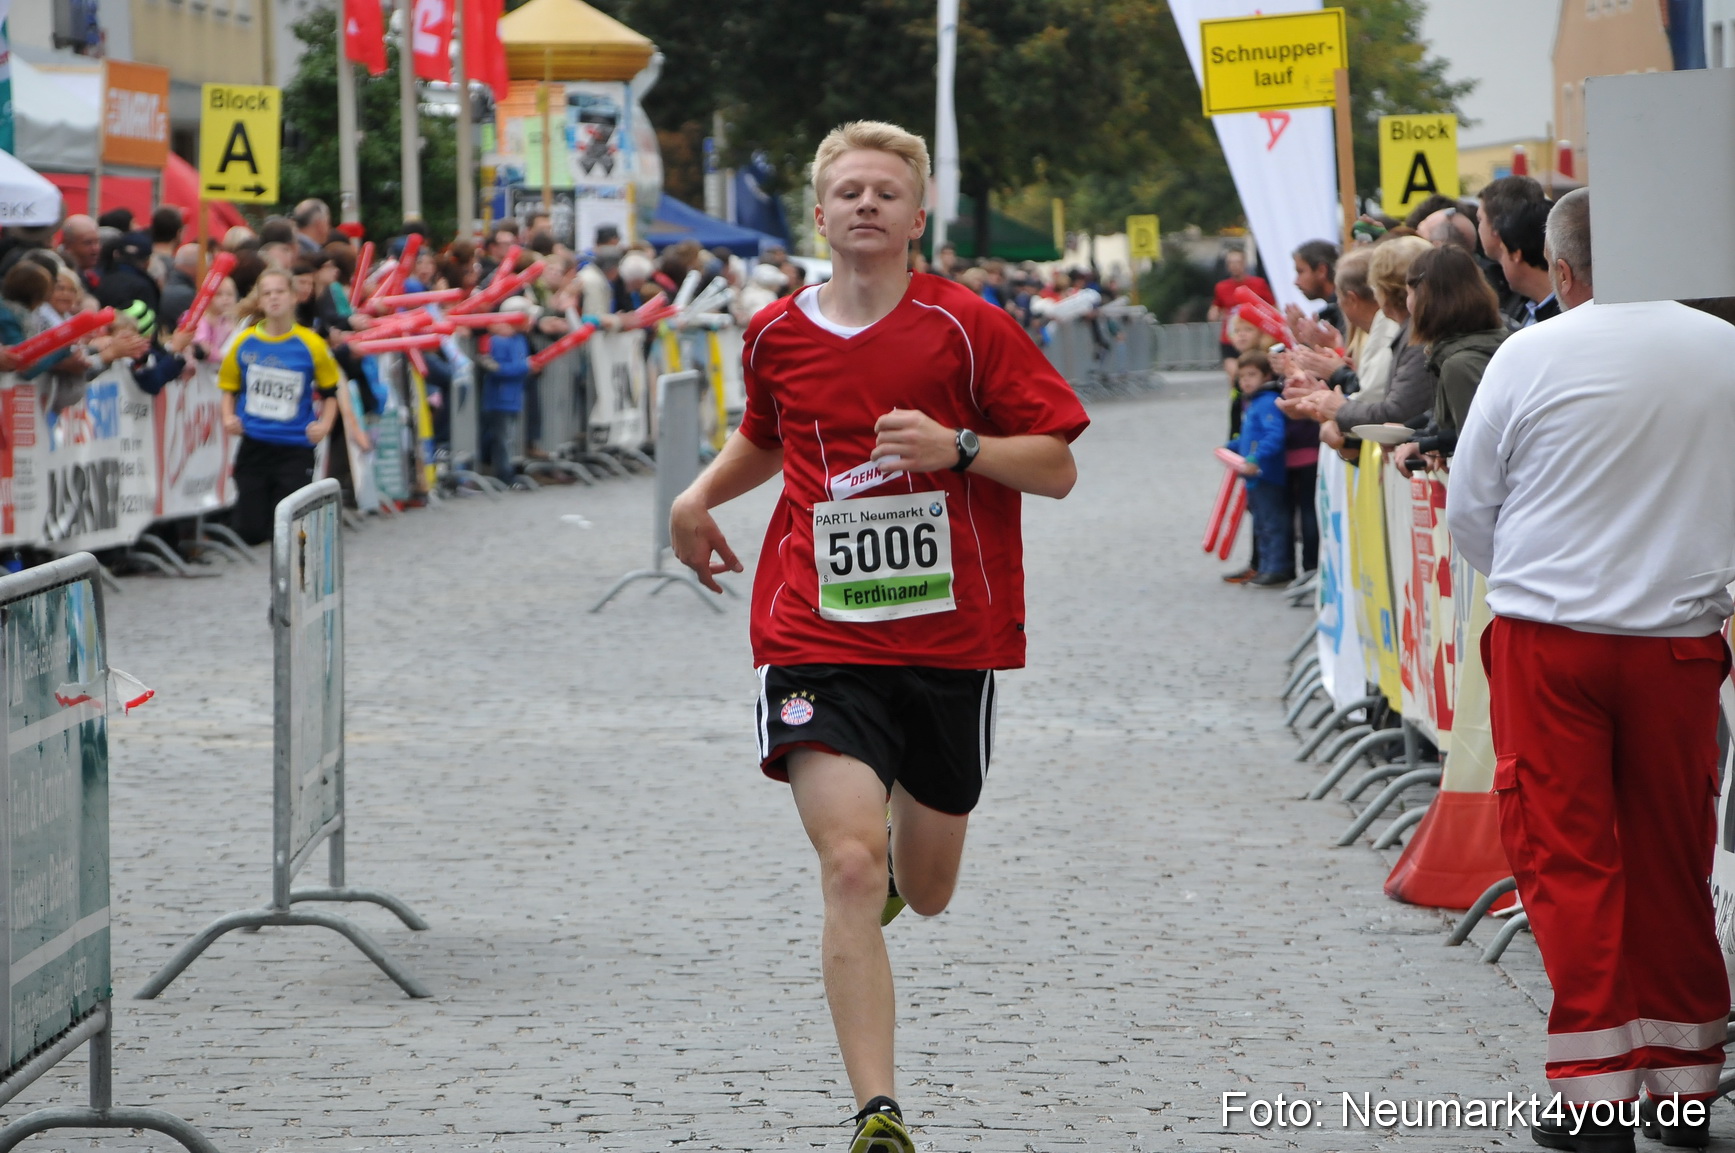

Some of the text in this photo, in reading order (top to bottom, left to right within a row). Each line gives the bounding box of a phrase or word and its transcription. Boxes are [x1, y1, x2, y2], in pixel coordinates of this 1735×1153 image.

[1211, 41, 1334, 64] Schnupper-
[1254, 66, 1294, 87] lauf
[210, 88, 270, 111] Block
[1391, 120, 1450, 141] Block
[218, 121, 259, 175] A
[1401, 150, 1438, 205] A
[250, 379, 296, 401] 4035
[815, 507, 924, 527] PARTL Neumarkt
[829, 522, 938, 576] 5006
[843, 580, 928, 606] Ferdinand
